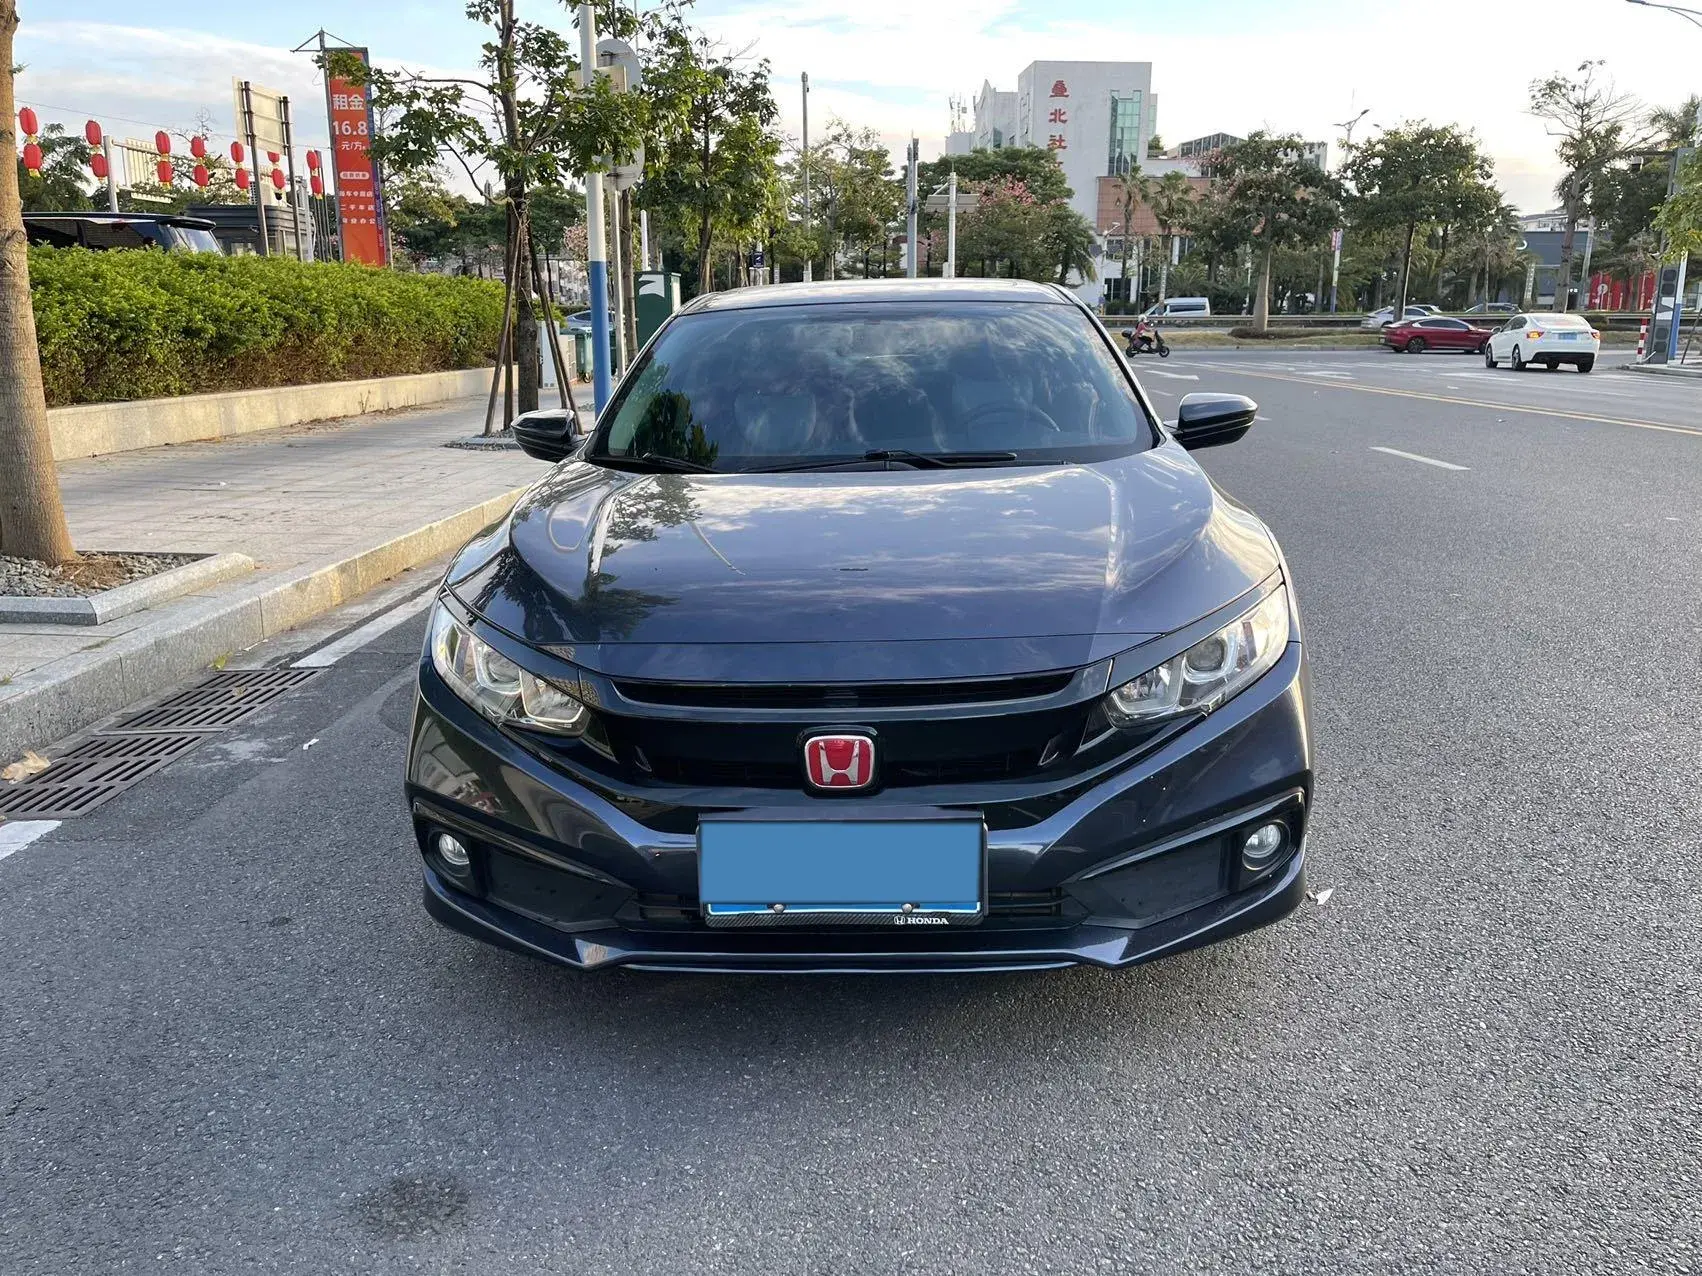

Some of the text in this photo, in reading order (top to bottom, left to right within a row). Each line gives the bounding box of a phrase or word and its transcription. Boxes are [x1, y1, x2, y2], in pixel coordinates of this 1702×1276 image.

[332, 94, 364, 110] 租金
[333, 120, 368, 136] 16.8
[907, 917, 949, 925] HONDA
